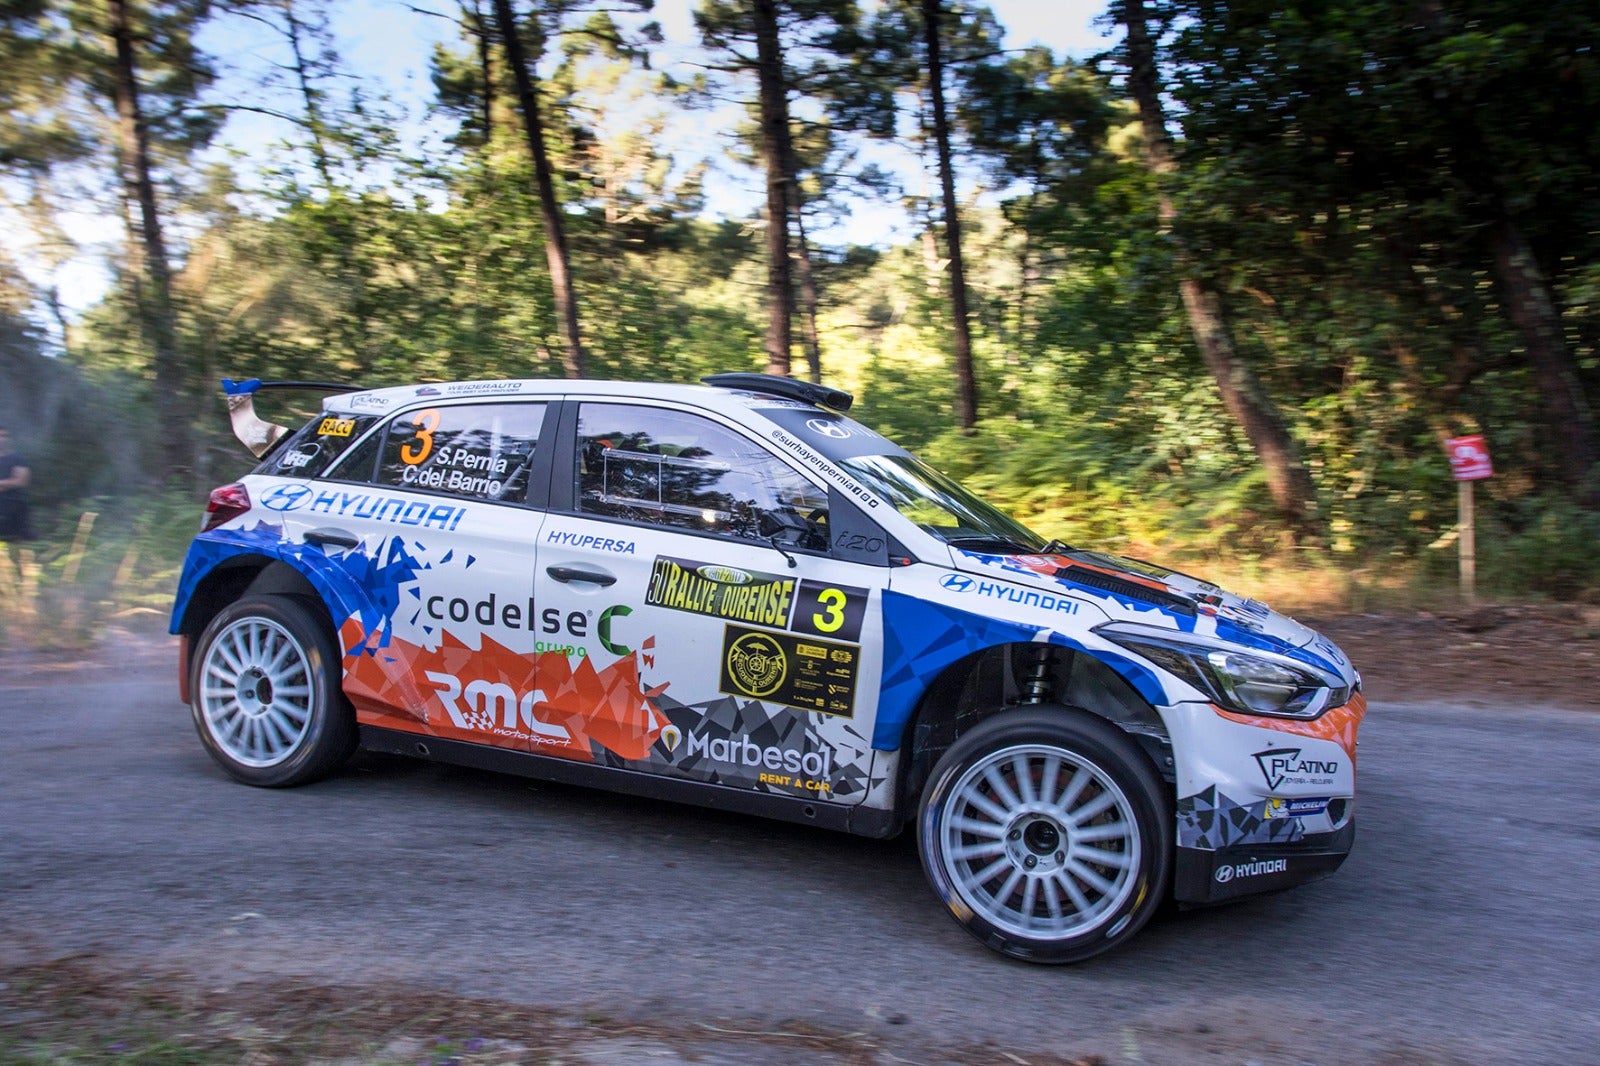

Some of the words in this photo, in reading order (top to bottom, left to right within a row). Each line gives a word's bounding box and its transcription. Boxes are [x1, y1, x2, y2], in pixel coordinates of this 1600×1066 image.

[448, 382, 522, 391] WEIDERAUTO
[321, 421, 352, 434] RACC
[401, 408, 441, 466] 3
[436, 446, 508, 473] S.Pernía
[771, 429, 855, 491] @surhayenpernia
[402, 464, 447, 487] C.del
[448, 470, 501, 495] Barrio
[310, 490, 467, 531] HYUNDAI
[547, 531, 636, 554] HYUPERSA
[647, 558, 671, 604] 50
[664, 562, 718, 614] RALLYE
[720, 580, 794, 627] OURENSE
[978, 580, 1079, 616] HYUNDAI
[812, 588, 847, 633] 3
[535, 639, 587, 659] grupo
[493, 728, 571, 747] motorsport
[687, 728, 831, 778] Marbesol
[1272, 758, 1338, 777] PLATINO
[759, 773, 791, 786] RENT
[793, 778, 802, 789] A
[805, 780, 831, 793] CAR
[1235, 858, 1287, 878] HYUNDAI
